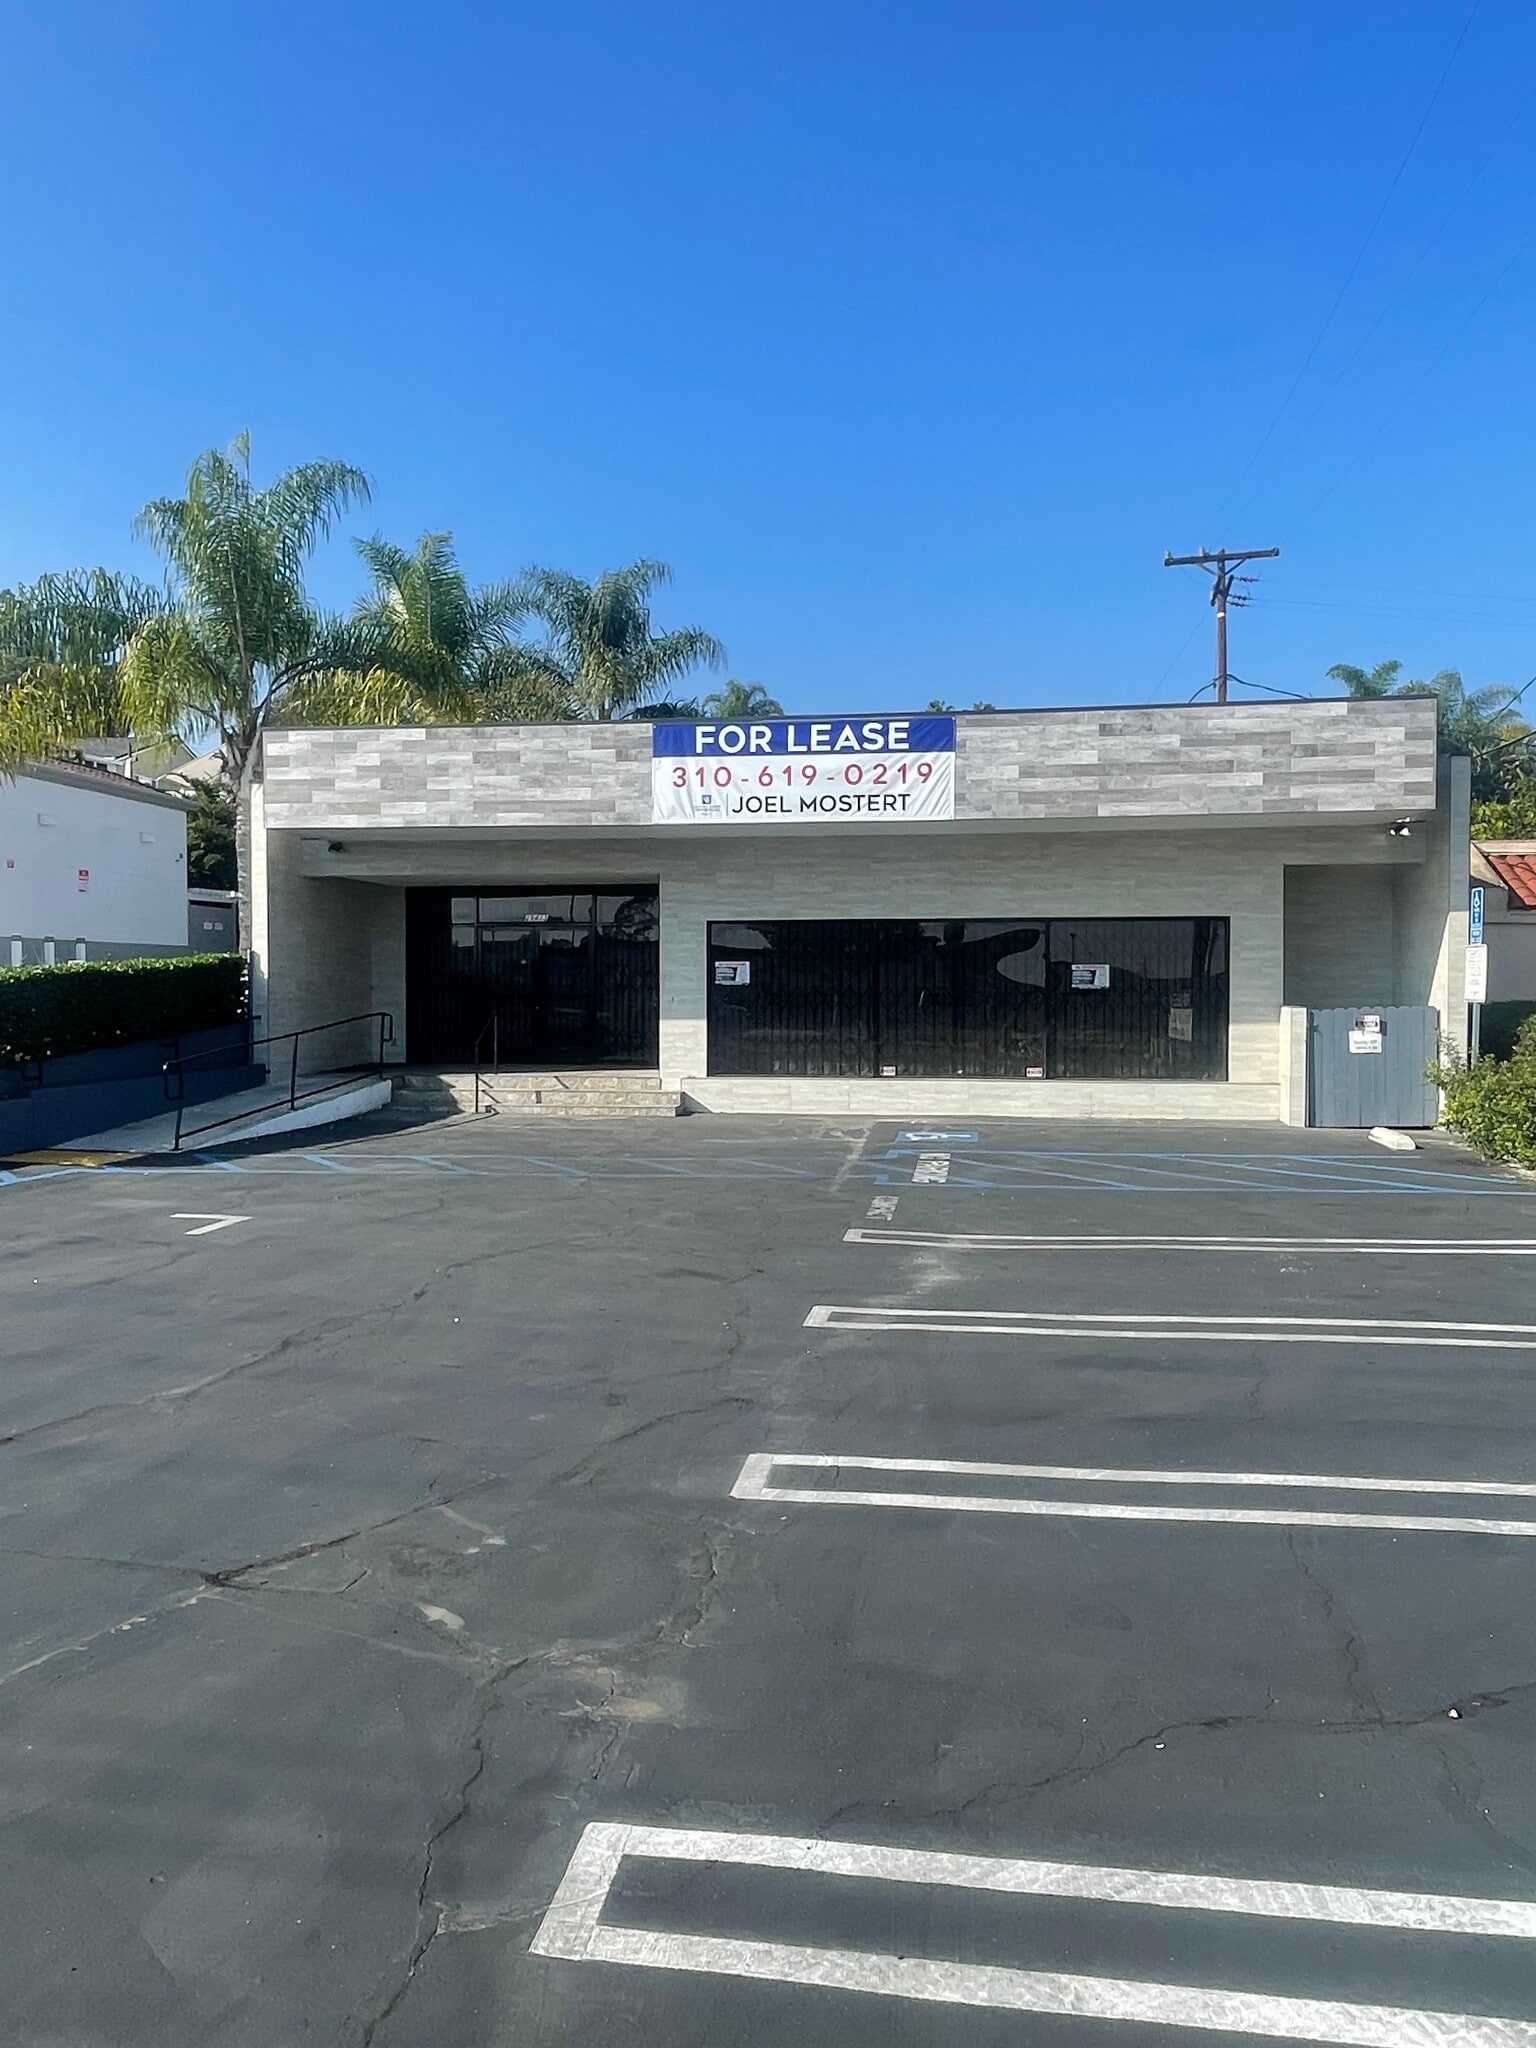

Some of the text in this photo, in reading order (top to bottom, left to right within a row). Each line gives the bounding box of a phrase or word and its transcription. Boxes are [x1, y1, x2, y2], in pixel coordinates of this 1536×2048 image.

[695, 721, 910, 754] FOR LEASE
[672, 762, 933, 788] 310-619-0219
[732, 795, 792, 814] JOEL
[800, 793, 911, 813] MOSTERT
